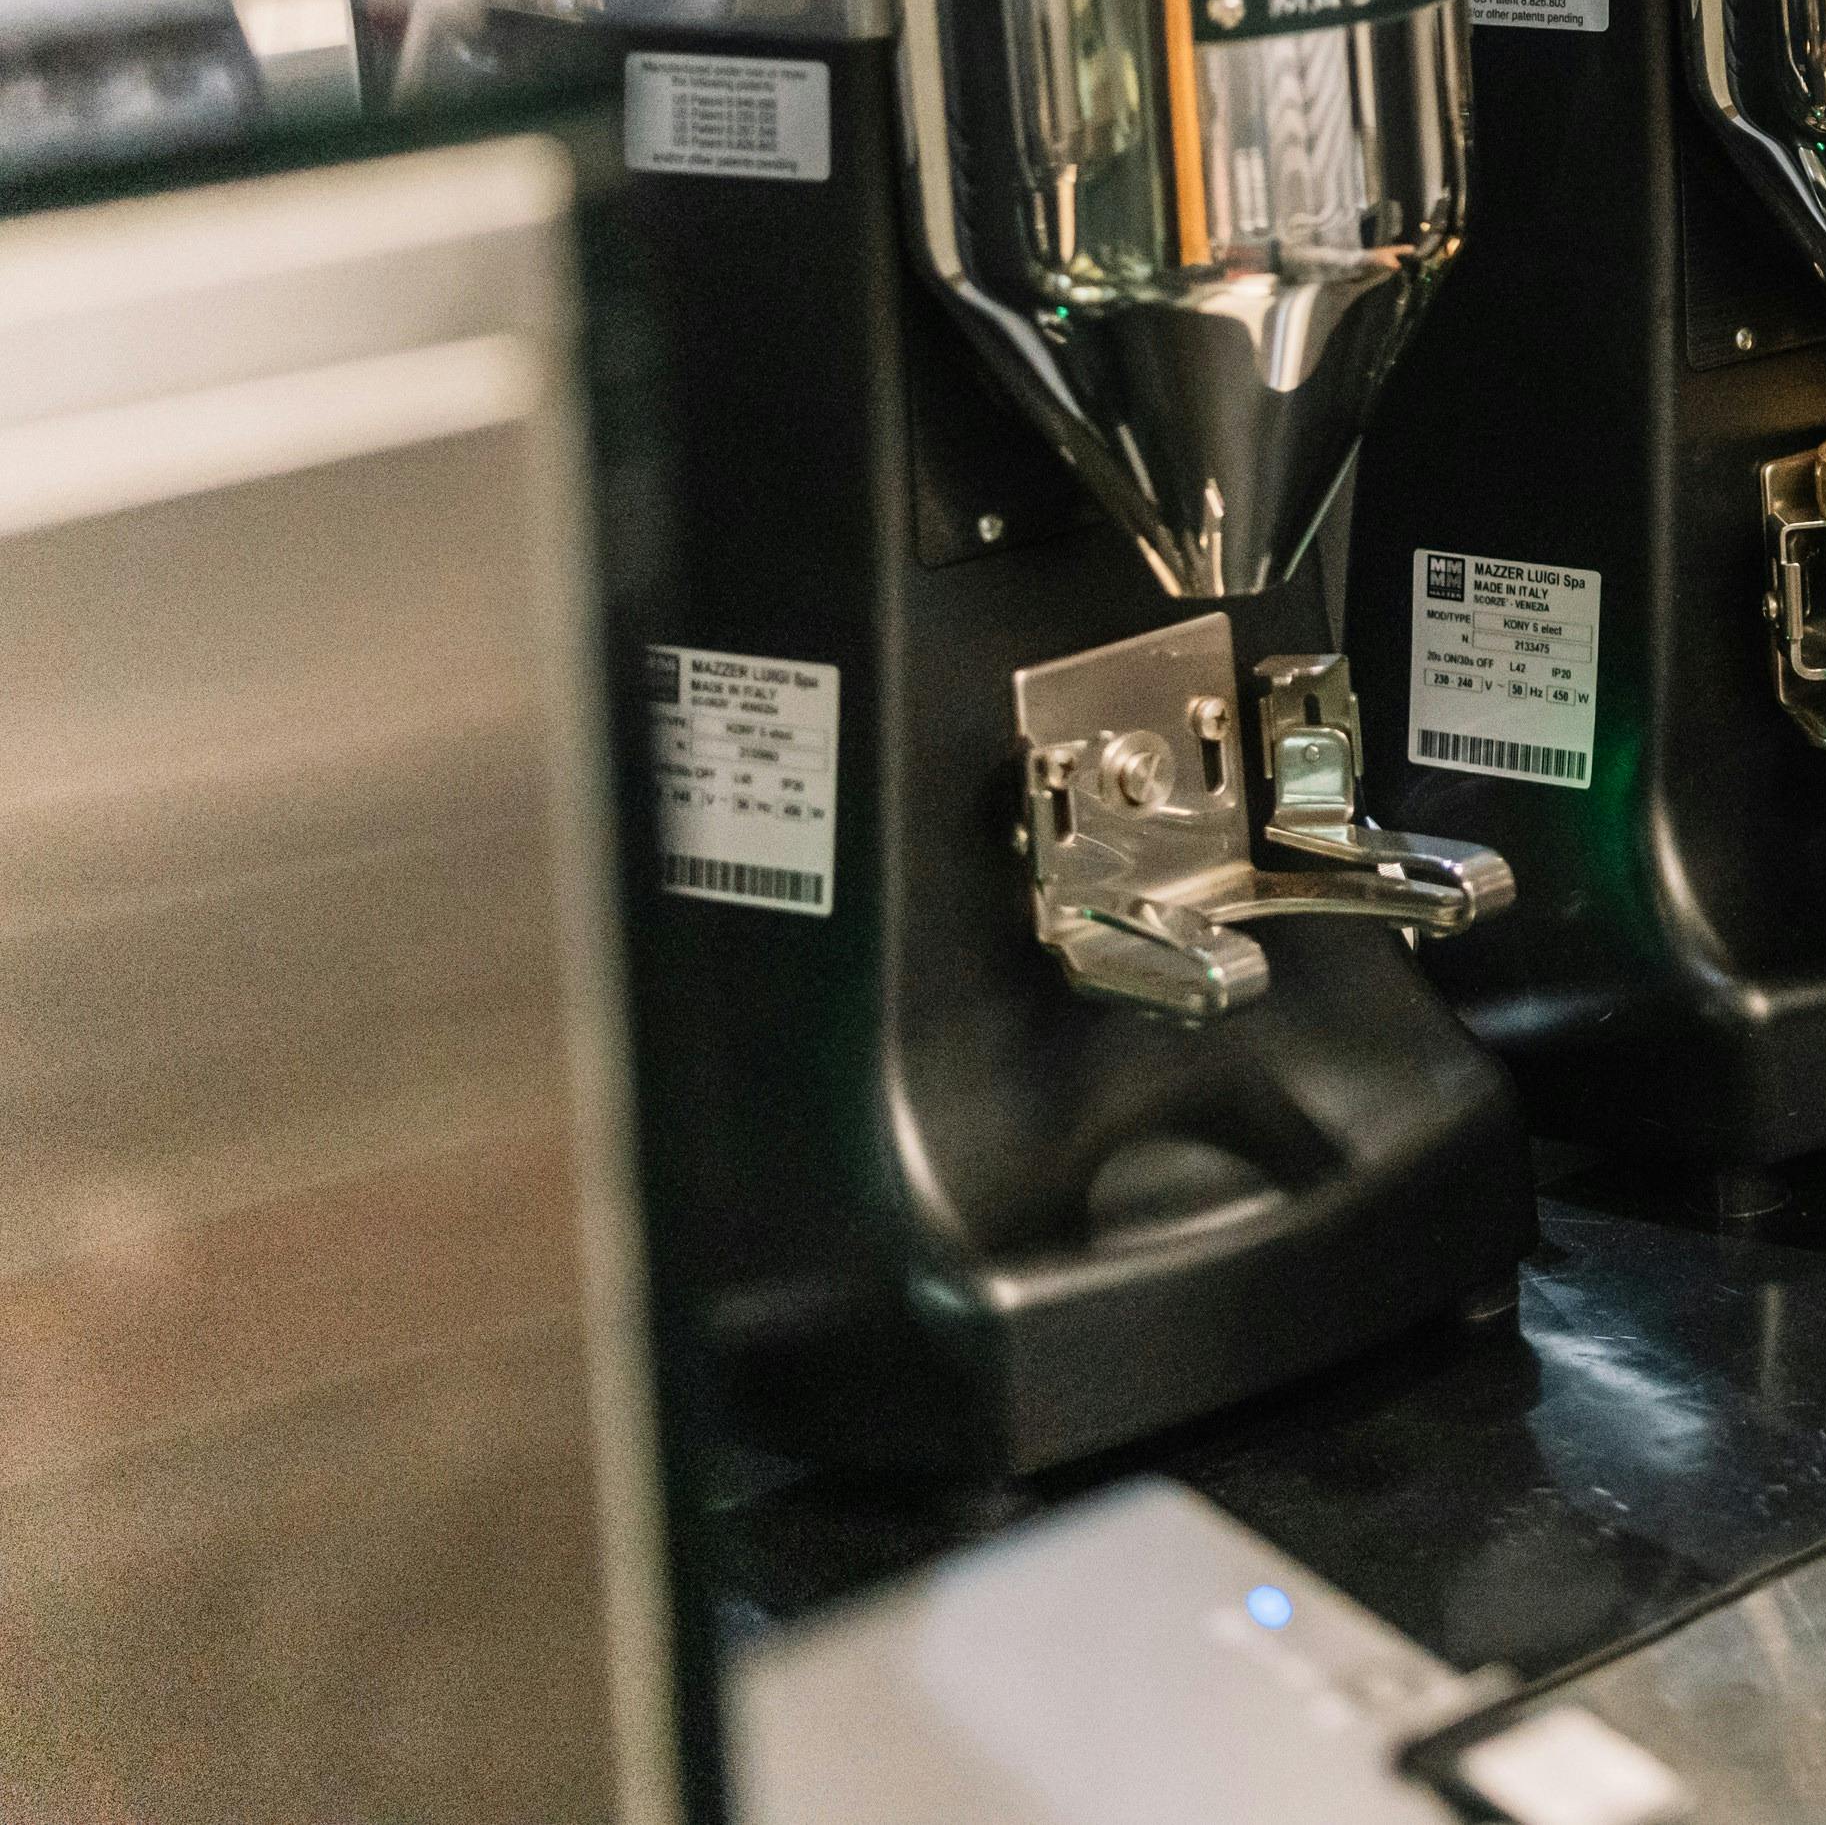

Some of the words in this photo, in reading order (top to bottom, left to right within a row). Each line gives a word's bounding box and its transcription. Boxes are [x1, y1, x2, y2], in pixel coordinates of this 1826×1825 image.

[1486, 8, 1509, 21] other
[1511, 10, 1545, 23] patents
[1547, 12, 1584, 27] pending
[1474, 562, 1524, 581] MAZZER
[1527, 568, 1560, 586] LUIGI
[1563, 574, 1586, 590] Spa
[1474, 580, 1503, 595] MADE
[1506, 584, 1516, 596] IN
[1519, 584, 1549, 600] ITALY
[1515, 599, 1550, 612] VENEZIA
[1503, 618, 1529, 631] KONY
[1541, 622, 1563, 636] elect
[1476, 656, 1494, 669] OFF
[1485, 680, 1493, 691] V
[1529, 687, 1544, 699] Hz
[1552, 689, 1569, 702] 450
[1578, 692, 1589, 704] W
